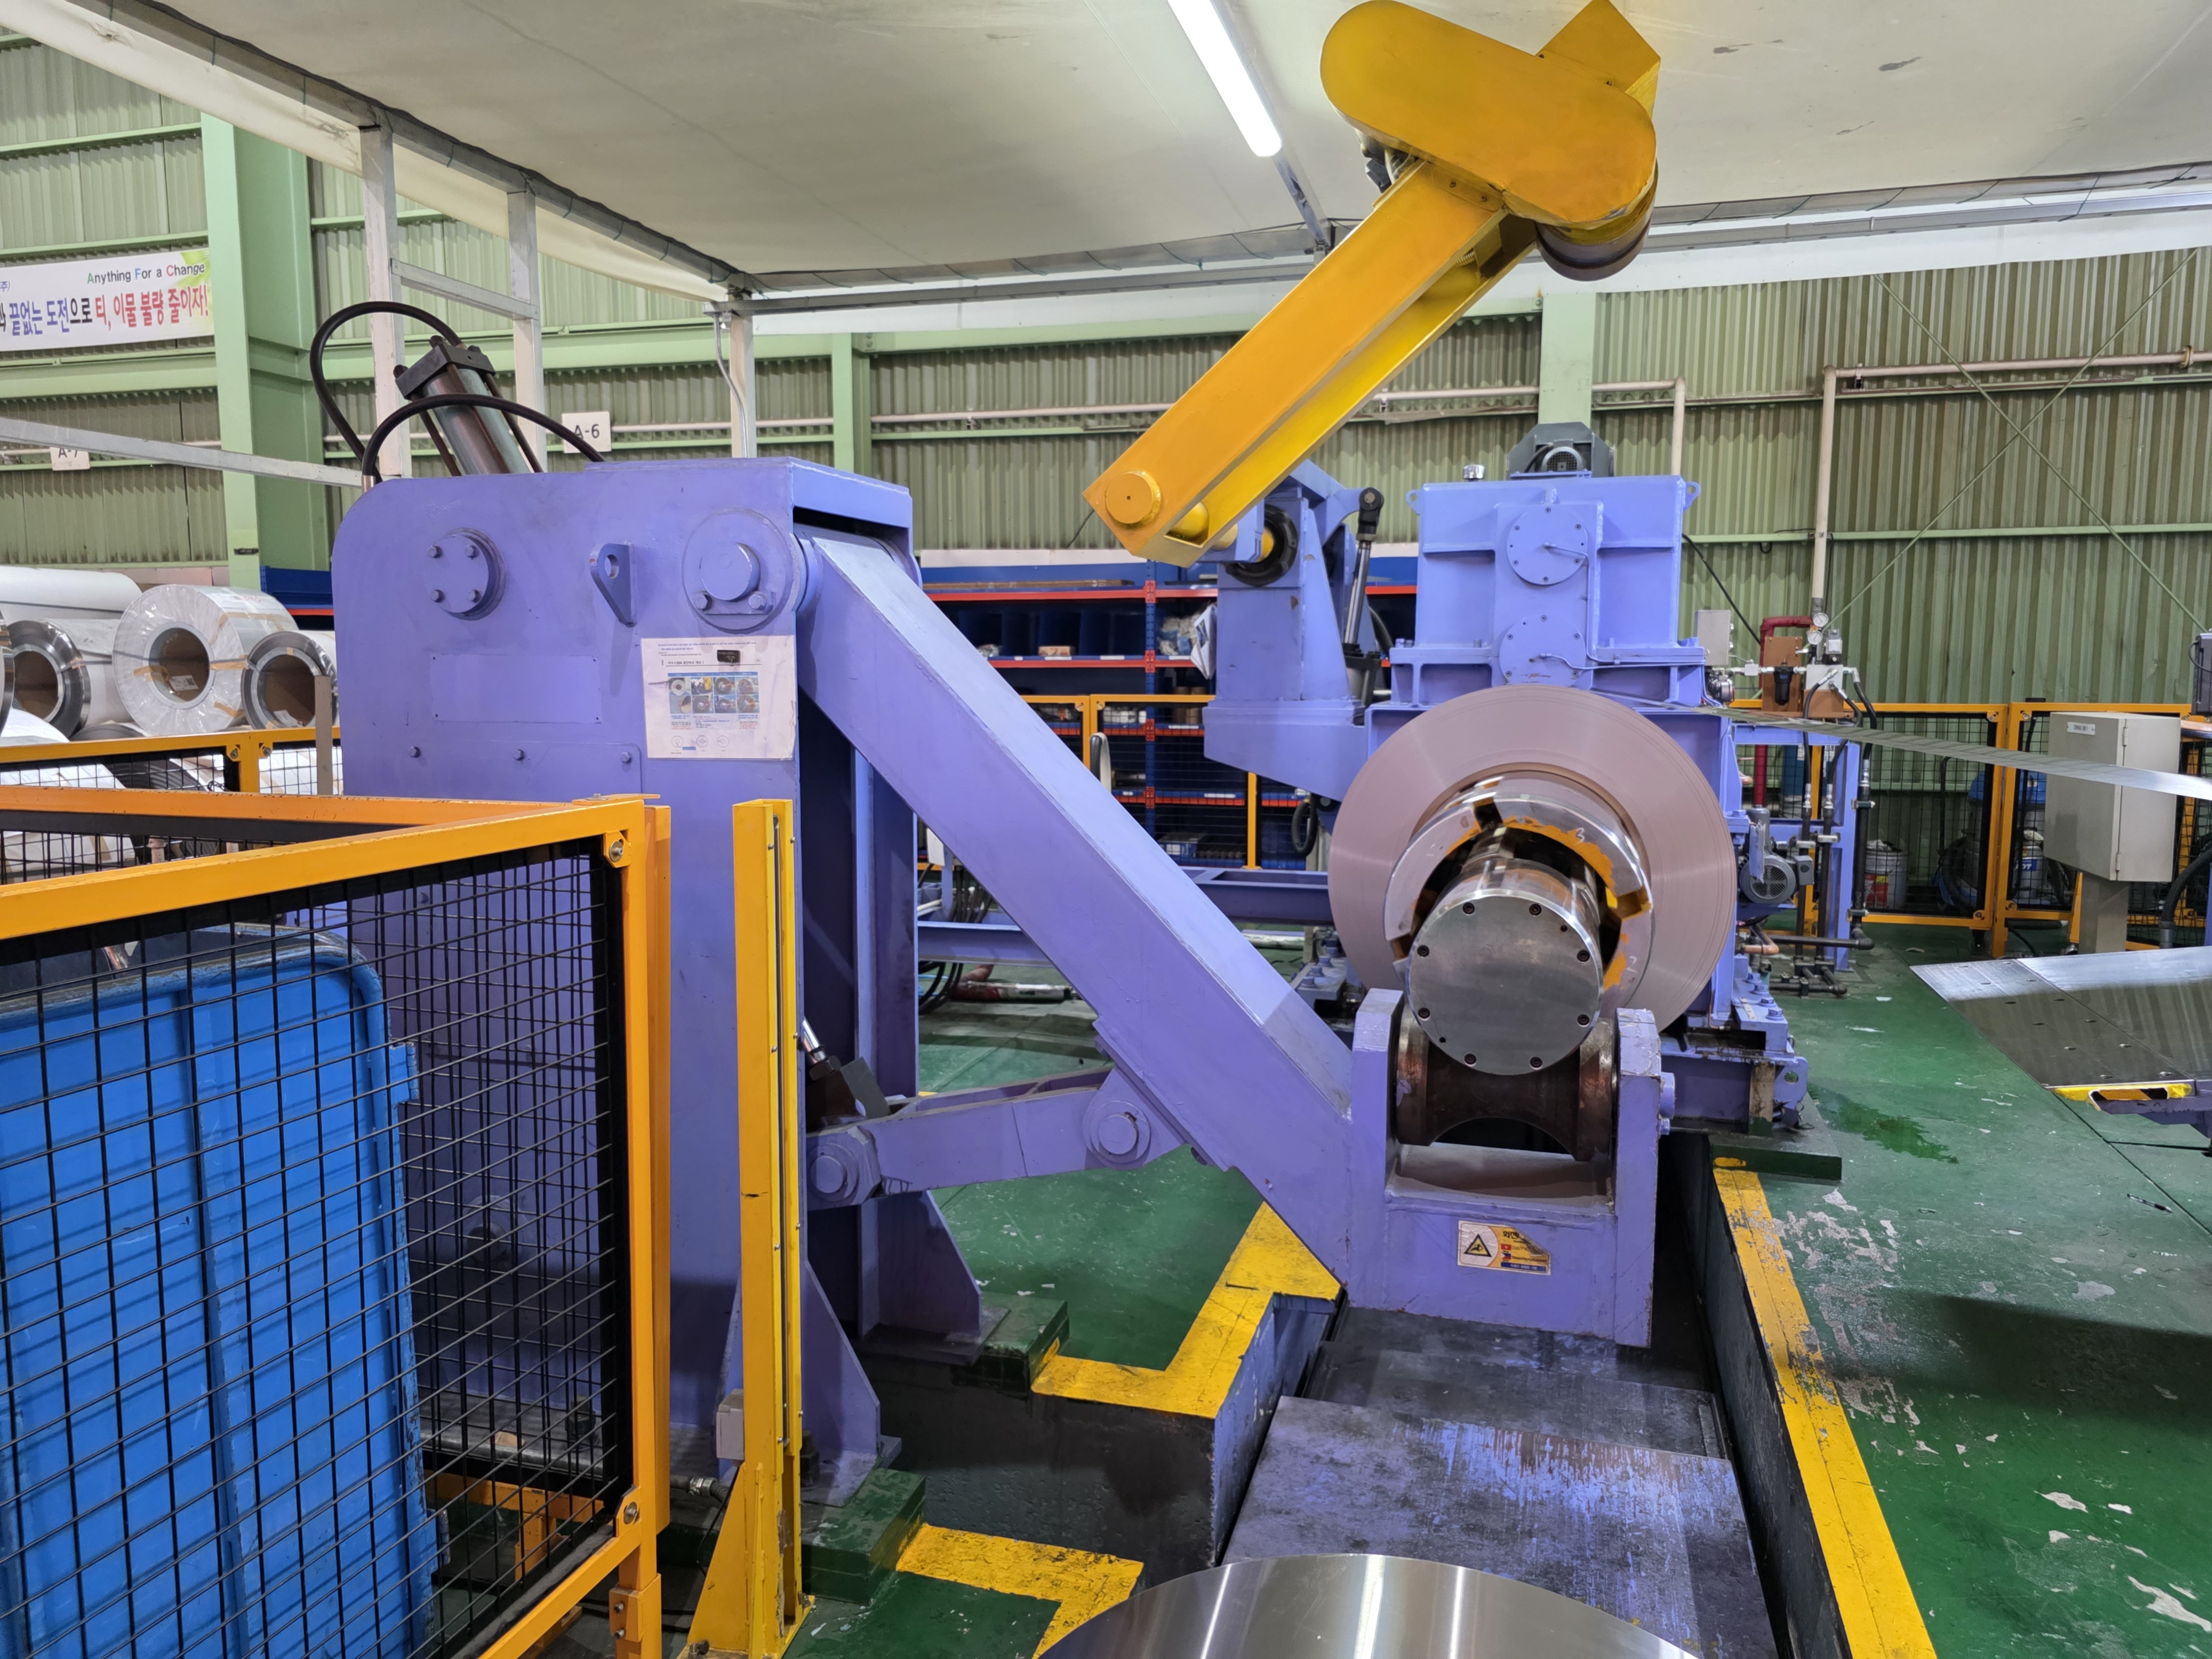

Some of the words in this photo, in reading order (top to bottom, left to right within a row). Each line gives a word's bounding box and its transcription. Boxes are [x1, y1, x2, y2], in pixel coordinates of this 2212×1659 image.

[87, 270, 131, 285] Anything
[135, 268, 152, 280] For
[156, 269, 162, 277] a
[166, 264, 205, 276] Change
[0, 281, 10, 292] 주)
[9, 300, 43, 336] 끝없는
[46, 297, 93, 333] 도전으로
[95, 294, 111, 331] 티,
[113, 293, 137, 327] 이물
[140, 289, 164, 327] 불량
[168, 284, 208, 324] 줄이자!
[574, 424, 600, 440] A-6
[1626, 955, 1637, 973] 2
